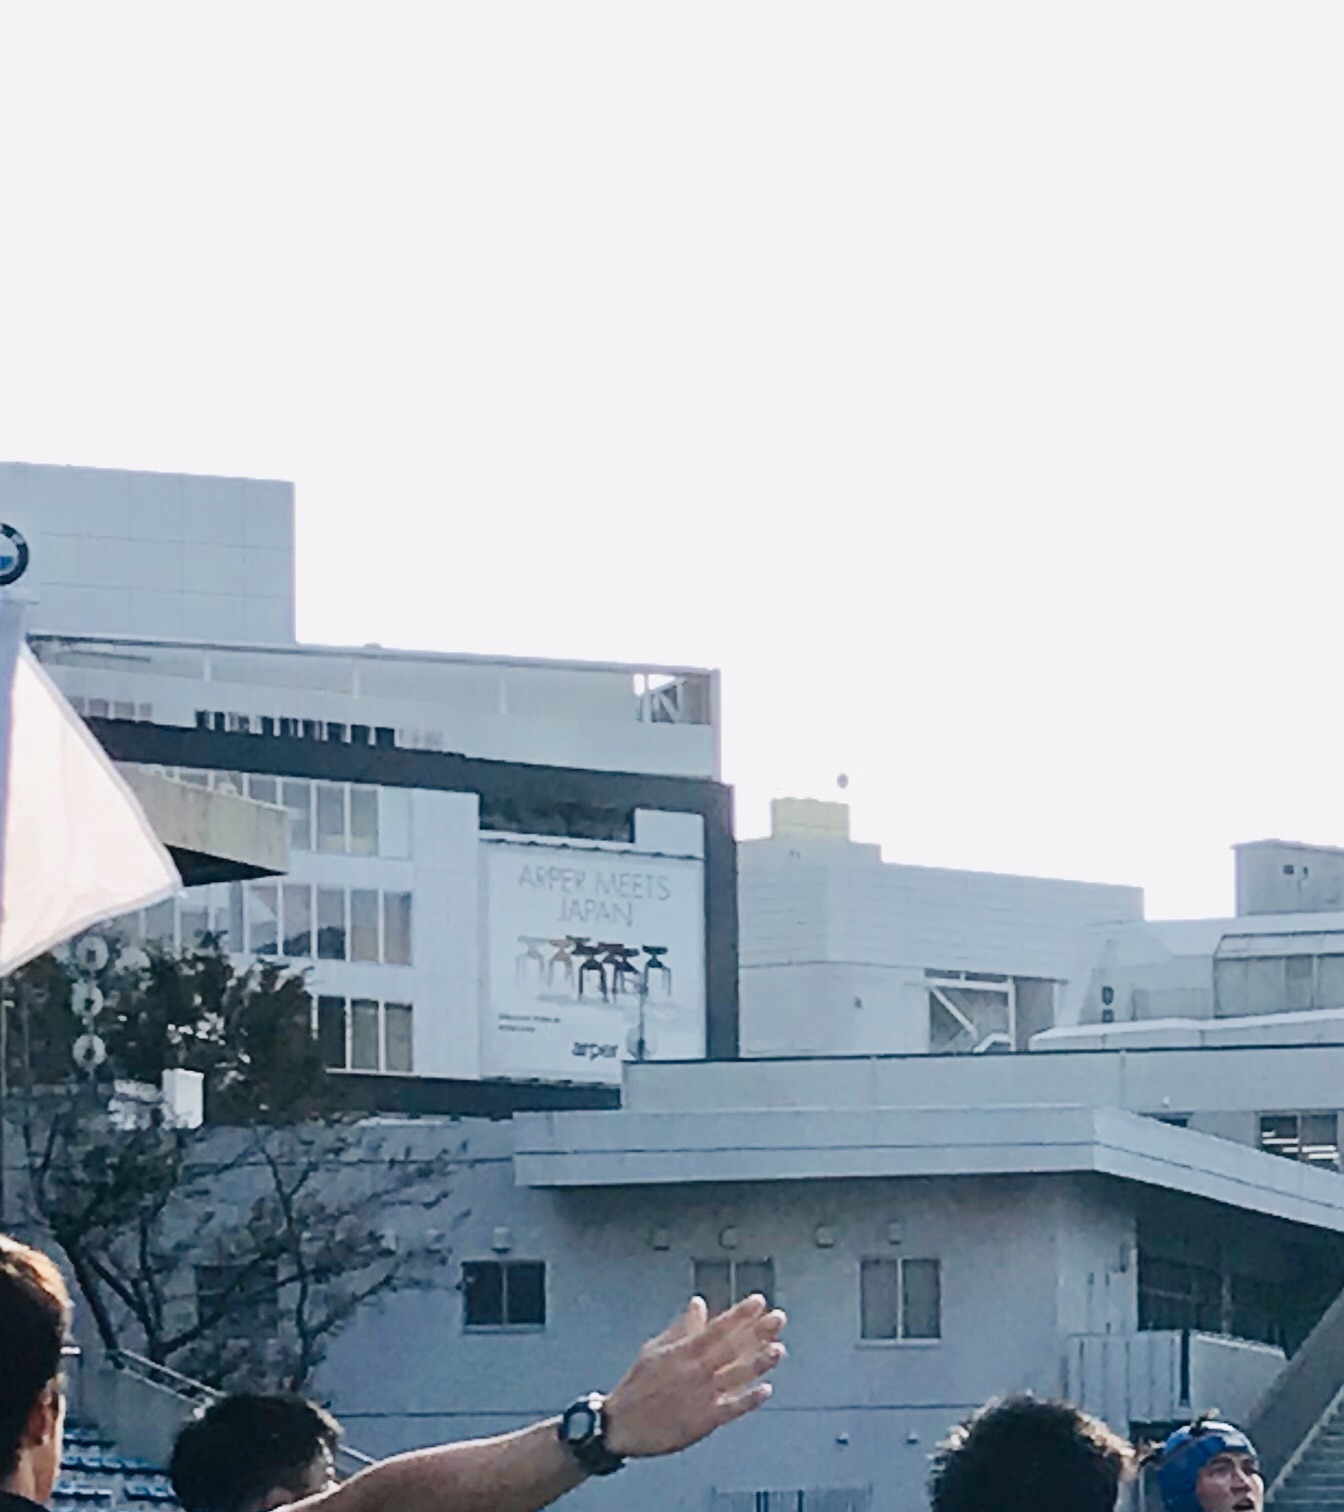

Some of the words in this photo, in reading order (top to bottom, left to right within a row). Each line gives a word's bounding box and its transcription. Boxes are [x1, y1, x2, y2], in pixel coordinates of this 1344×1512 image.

[518, 865, 585, 894] ARPER
[595, 872, 671, 901] MEETS
[558, 897, 632, 927] JAPAN
